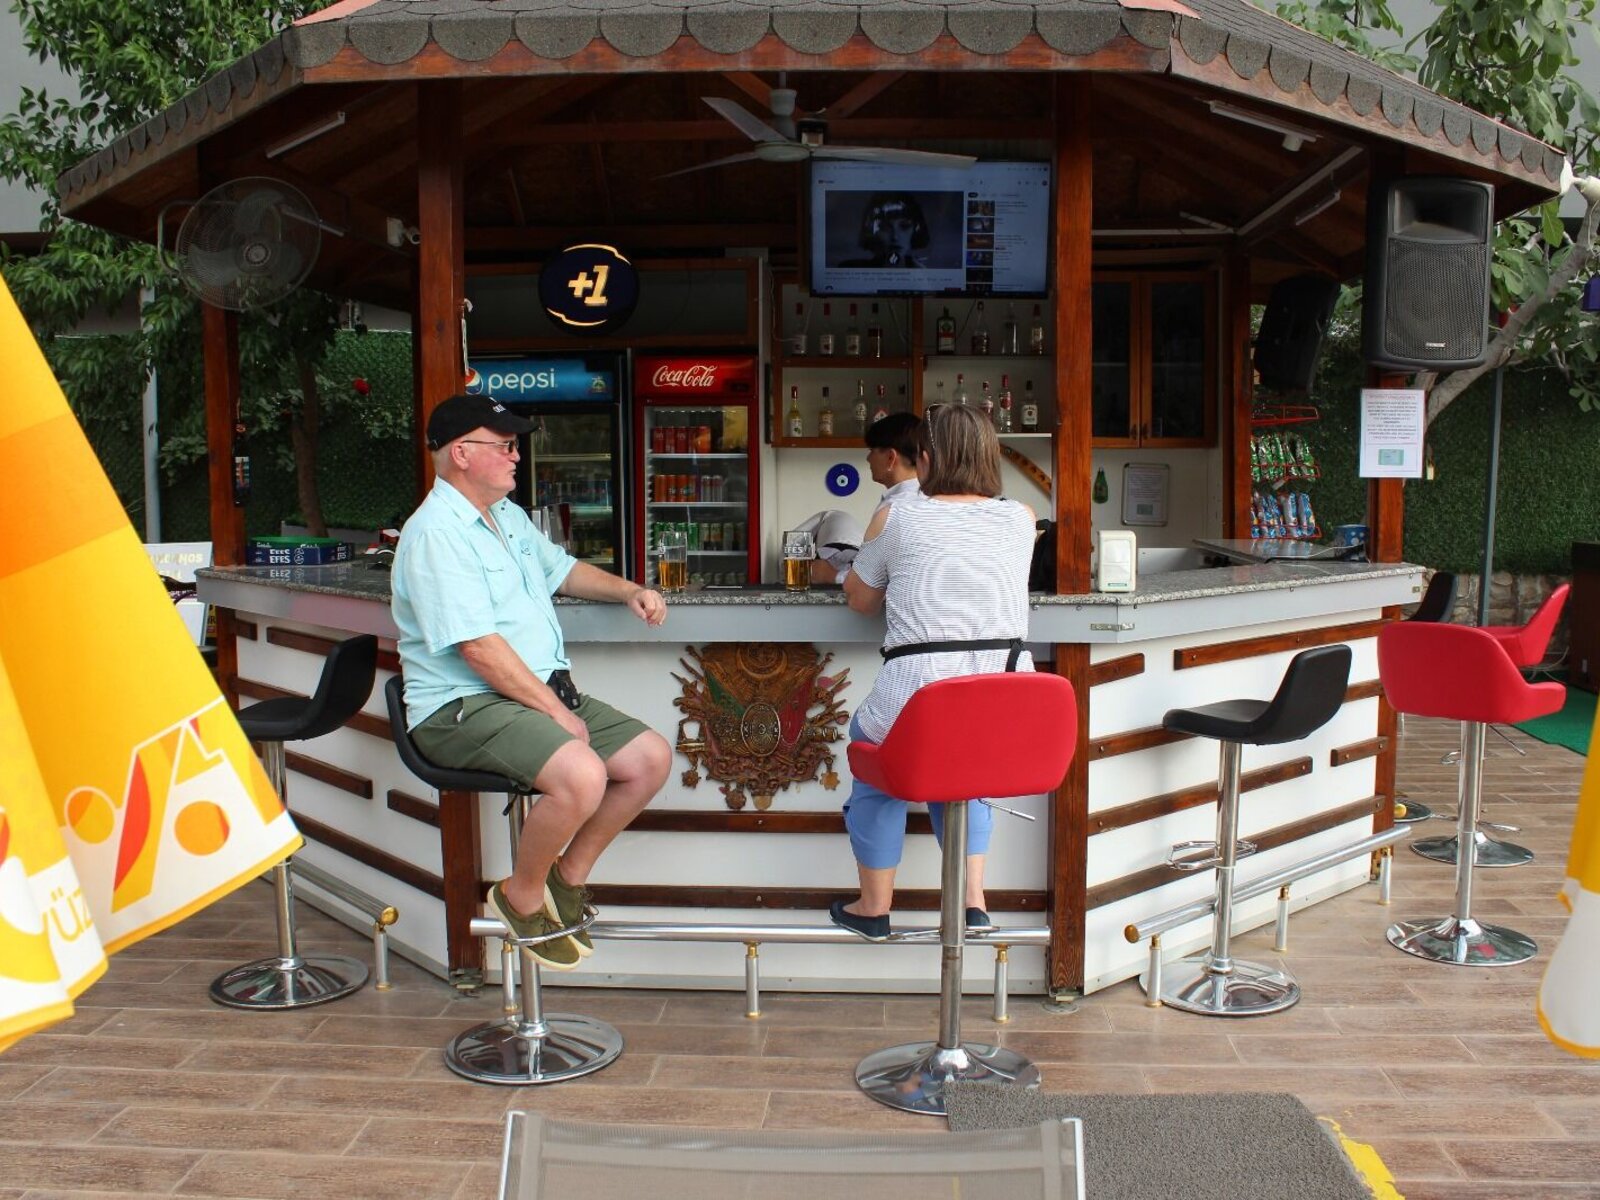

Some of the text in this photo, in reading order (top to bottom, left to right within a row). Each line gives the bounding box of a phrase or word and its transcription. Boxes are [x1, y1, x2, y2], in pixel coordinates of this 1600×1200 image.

[568, 265, 609, 306] +1
[488, 368, 555, 394] pepsi
[652, 365, 717, 387] Coca-Cola
[270, 556, 290, 564] EFES
[784, 546, 804, 554] EFES
